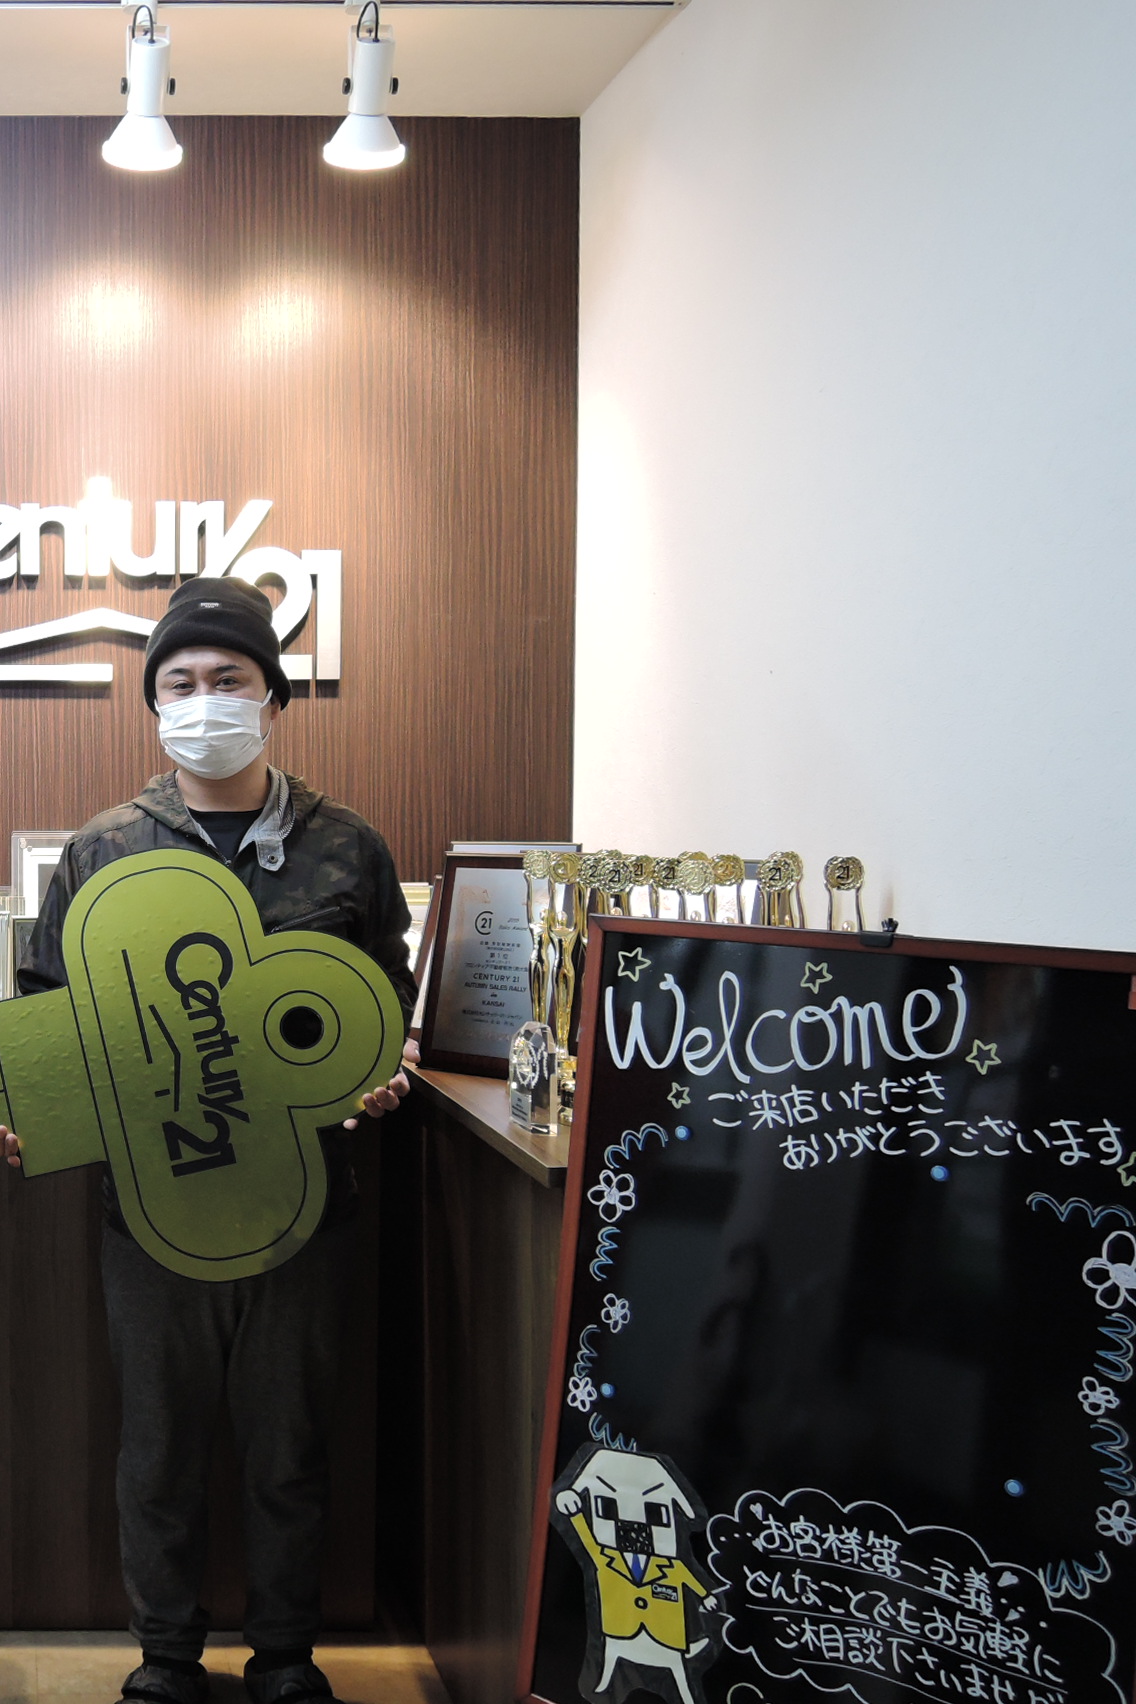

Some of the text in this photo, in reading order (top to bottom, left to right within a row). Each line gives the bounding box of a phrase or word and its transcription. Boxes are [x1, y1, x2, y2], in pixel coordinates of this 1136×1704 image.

[230, 546, 342, 680] 21
[609, 869, 621, 882] 21
[633, 863, 643, 876] 21
[663, 866, 675, 879] 21
[768, 867, 782, 881] 21
[836, 865, 850, 880] 21
[473, 972, 510, 982] CENTURY
[489, 983, 507, 991] SALES
[508, 985, 527, 993] RALLY
[605, 965, 967, 1083] Welcome
[162, 932, 250, 1178] Century 21
[707, 1071, 947, 1131] ご来店いただき
[780, 1115, 1124, 1171] ありがとうございます
[760, 1514, 998, 1621] お客様第一主義
[743, 1565, 1064, 1684] どんなことでもお気軽に
